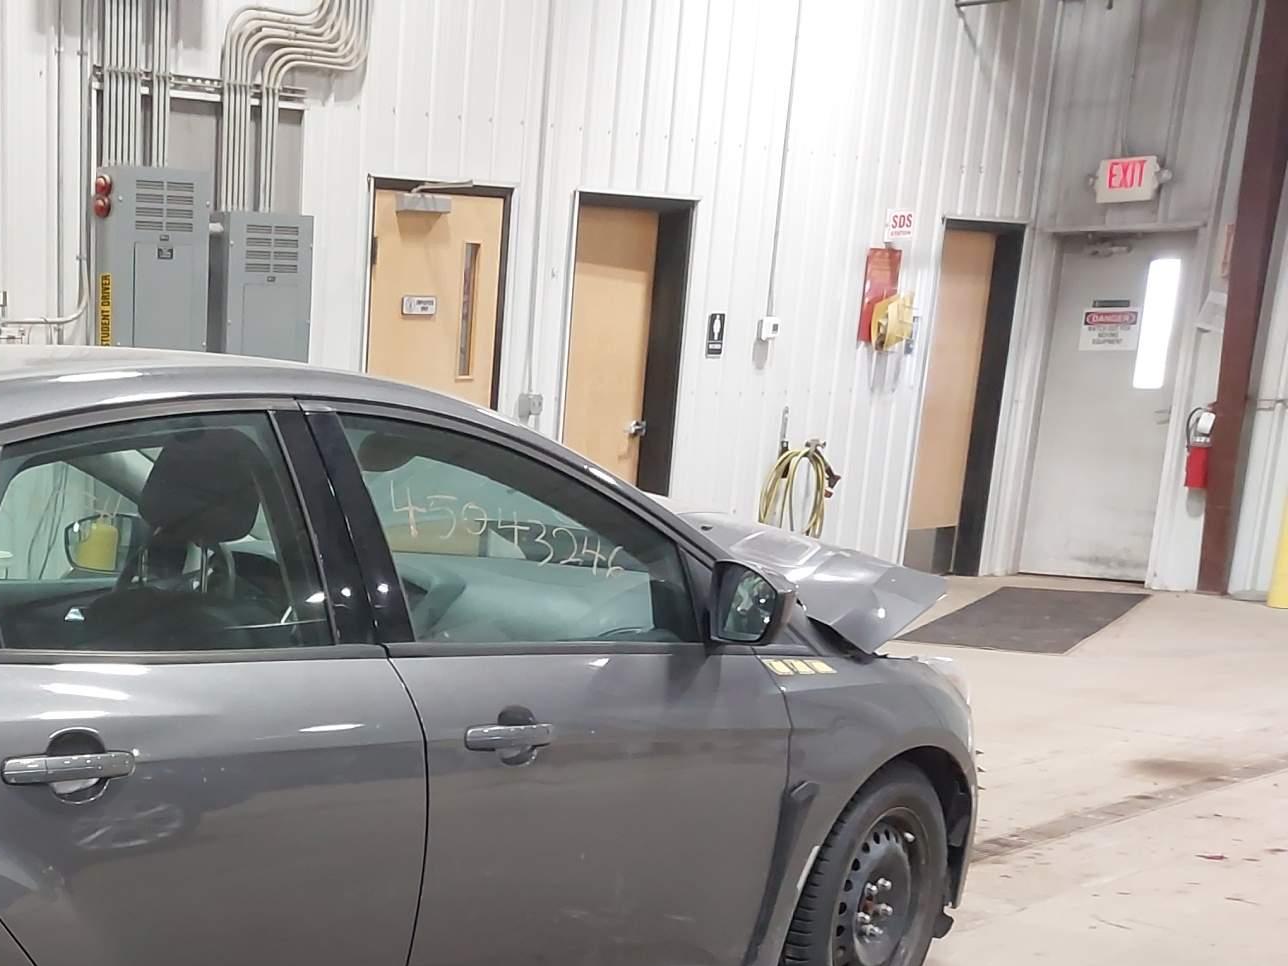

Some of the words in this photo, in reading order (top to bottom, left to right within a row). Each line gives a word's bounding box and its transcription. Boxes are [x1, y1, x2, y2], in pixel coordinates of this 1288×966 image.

[1108, 159, 1146, 189] EXIT
[892, 213, 912, 229] SDS
[101, 273, 110, 306] DRIVER
